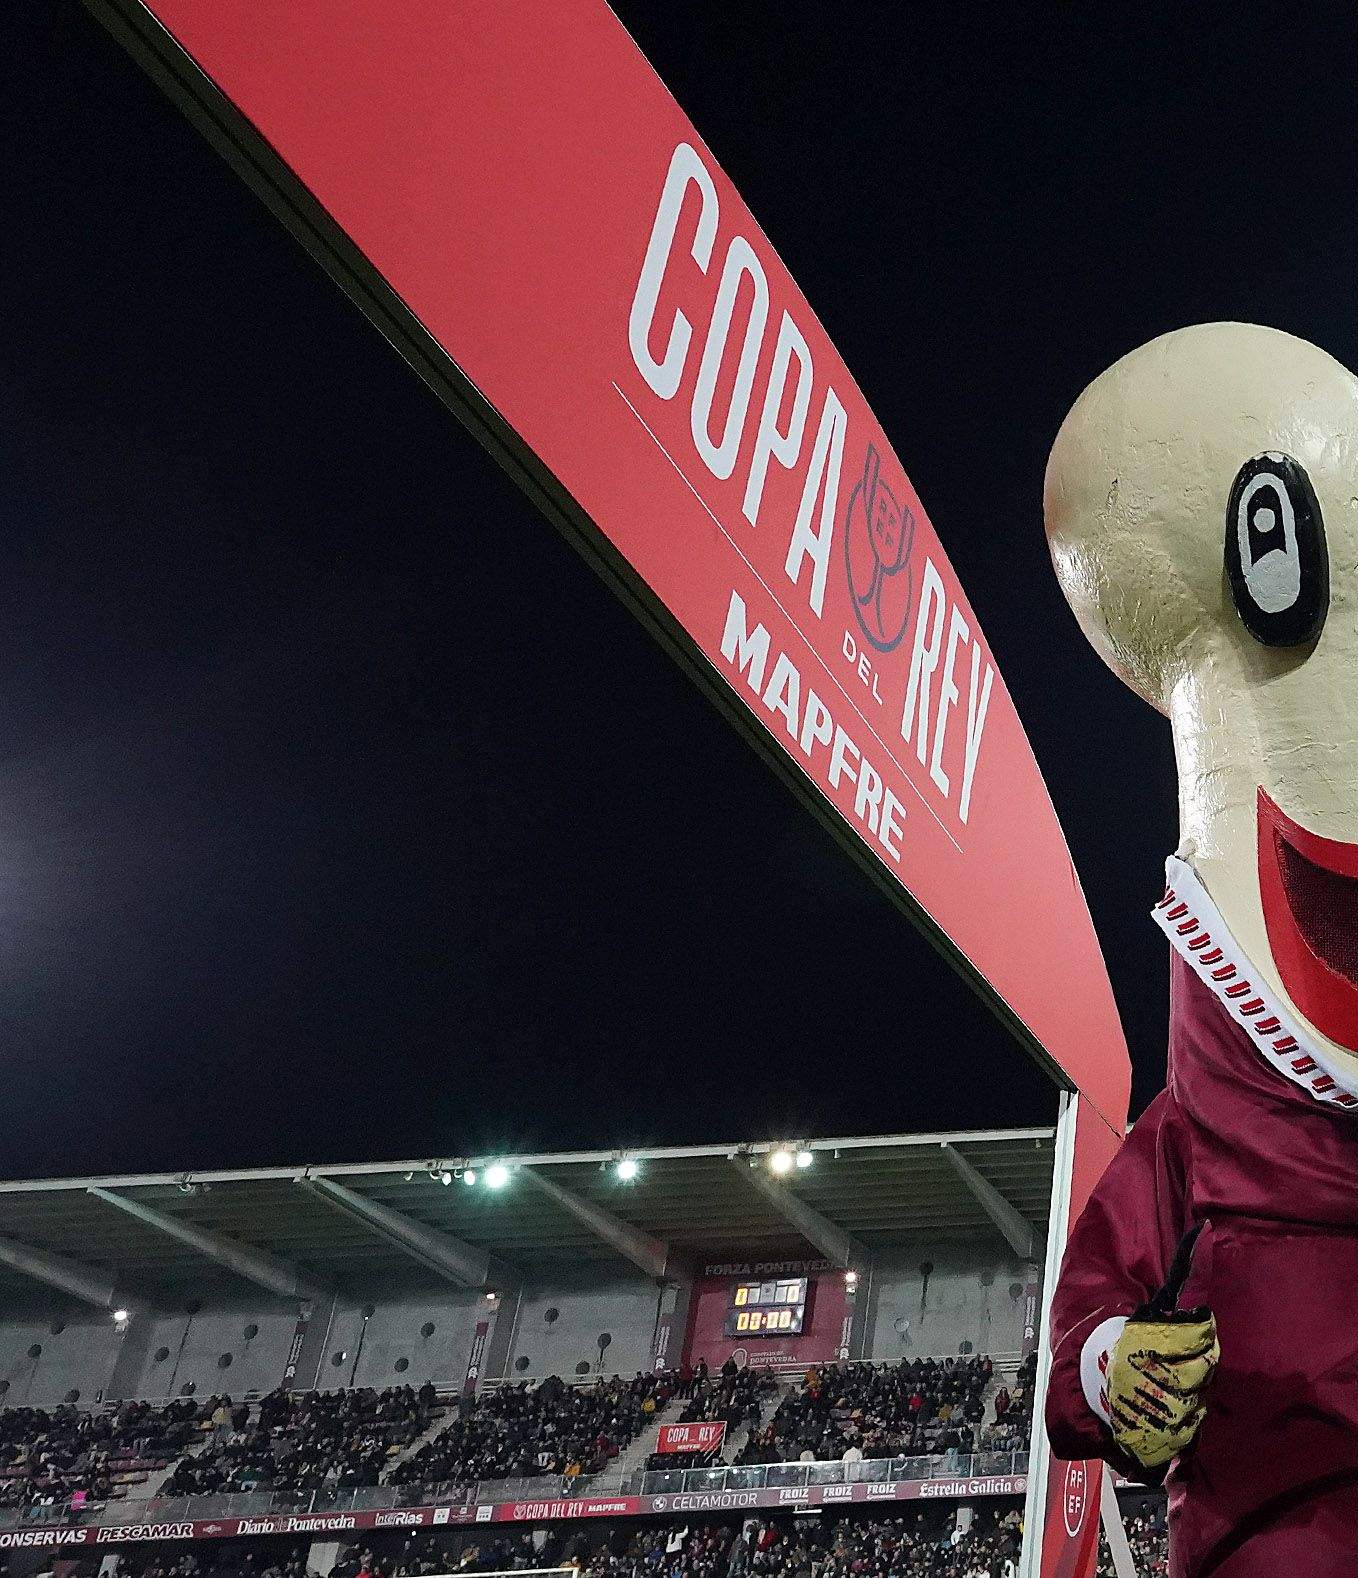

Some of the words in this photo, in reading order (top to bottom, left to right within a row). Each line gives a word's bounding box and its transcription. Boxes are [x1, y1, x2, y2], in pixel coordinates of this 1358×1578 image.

[628, 142, 848, 617] COPA
[842, 633, 884, 706] DEL
[901, 556, 994, 826] REY
[719, 588, 906, 864] MAPFRE
[667, 1427, 689, 1443] COPA
[698, 1426, 716, 1442] REY
[919, 1482, 966, 1497] Estrella
[969, 1478, 1012, 1494] Galicia
[1069, 1469, 1082, 1488] RF
[779, 1488, 809, 1499] FROIZ
[823, 1486, 853, 1497] FROIZ
[867, 1483, 896, 1494] FROIZ
[526, 1504, 548, 1519] COPA
[550, 1503, 567, 1518] DEL
[568, 1502, 584, 1517] REY
[673, 1493, 758, 1510] CELTAMOTOR
[1068, 1494, 1081, 1514] EF
[97, 1523, 194, 1542] PESCAMAR
[236, 1519, 275, 1535] Diario
[286, 1514, 356, 1532] Pontevedra
[0, 1529, 87, 1547] ONSERVAS
